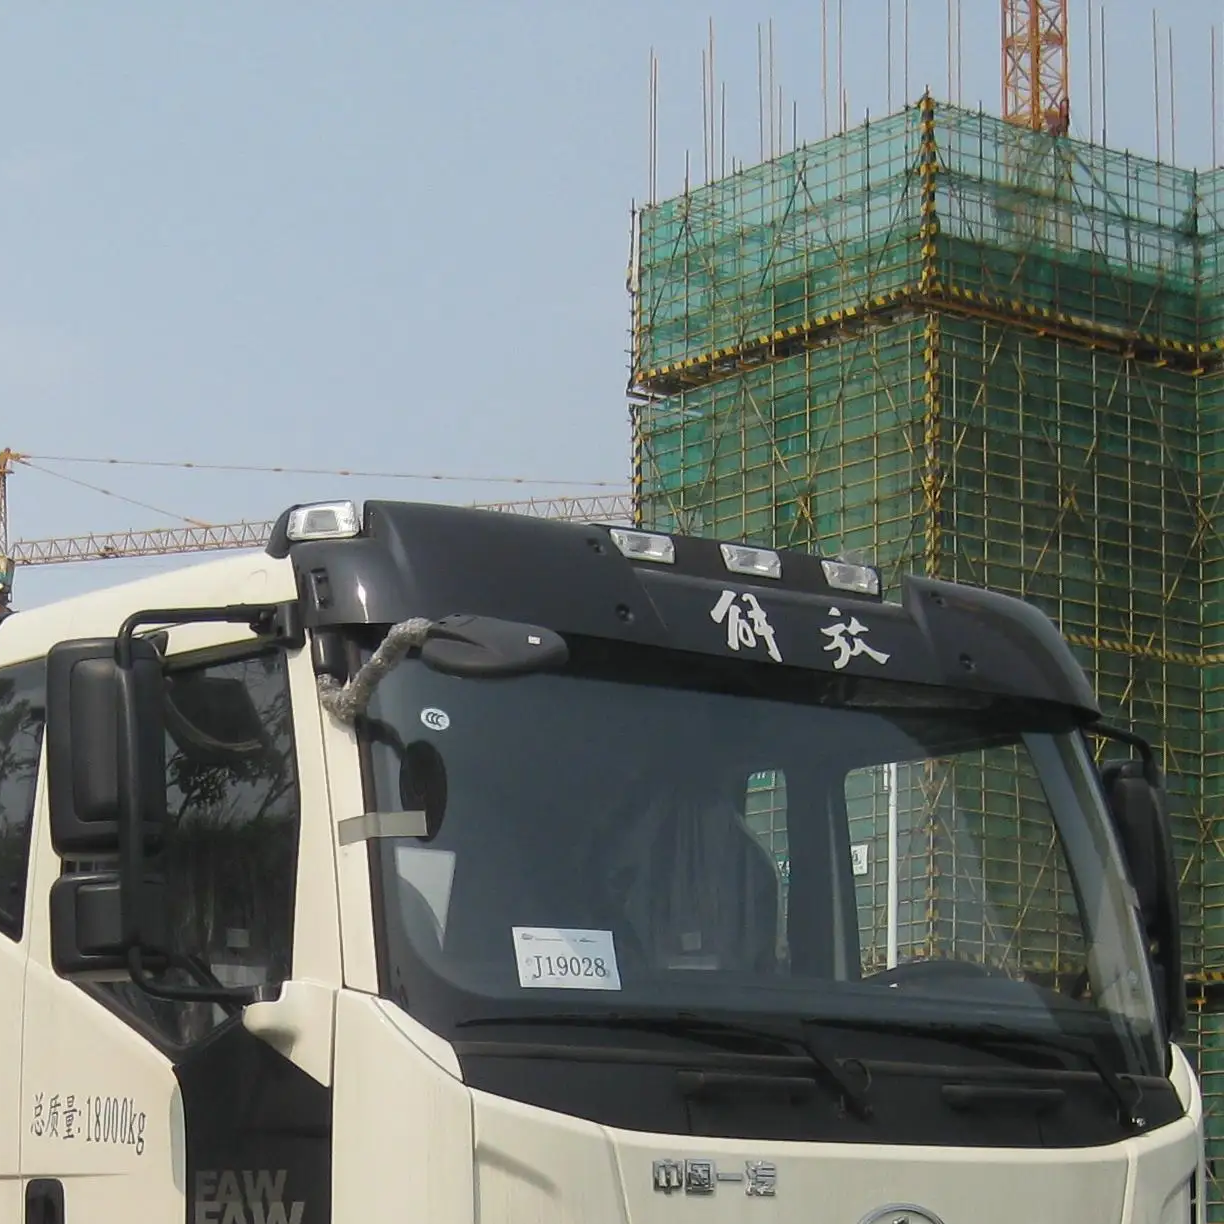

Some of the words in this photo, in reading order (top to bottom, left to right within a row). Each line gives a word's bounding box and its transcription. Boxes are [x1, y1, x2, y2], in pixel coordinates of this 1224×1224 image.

[710, 590, 891, 669] 解放
[532, 955, 607, 979] J19028
[194, 1169, 288, 1202] FAW
[652, 1158, 777, 1197] 中国一汽
